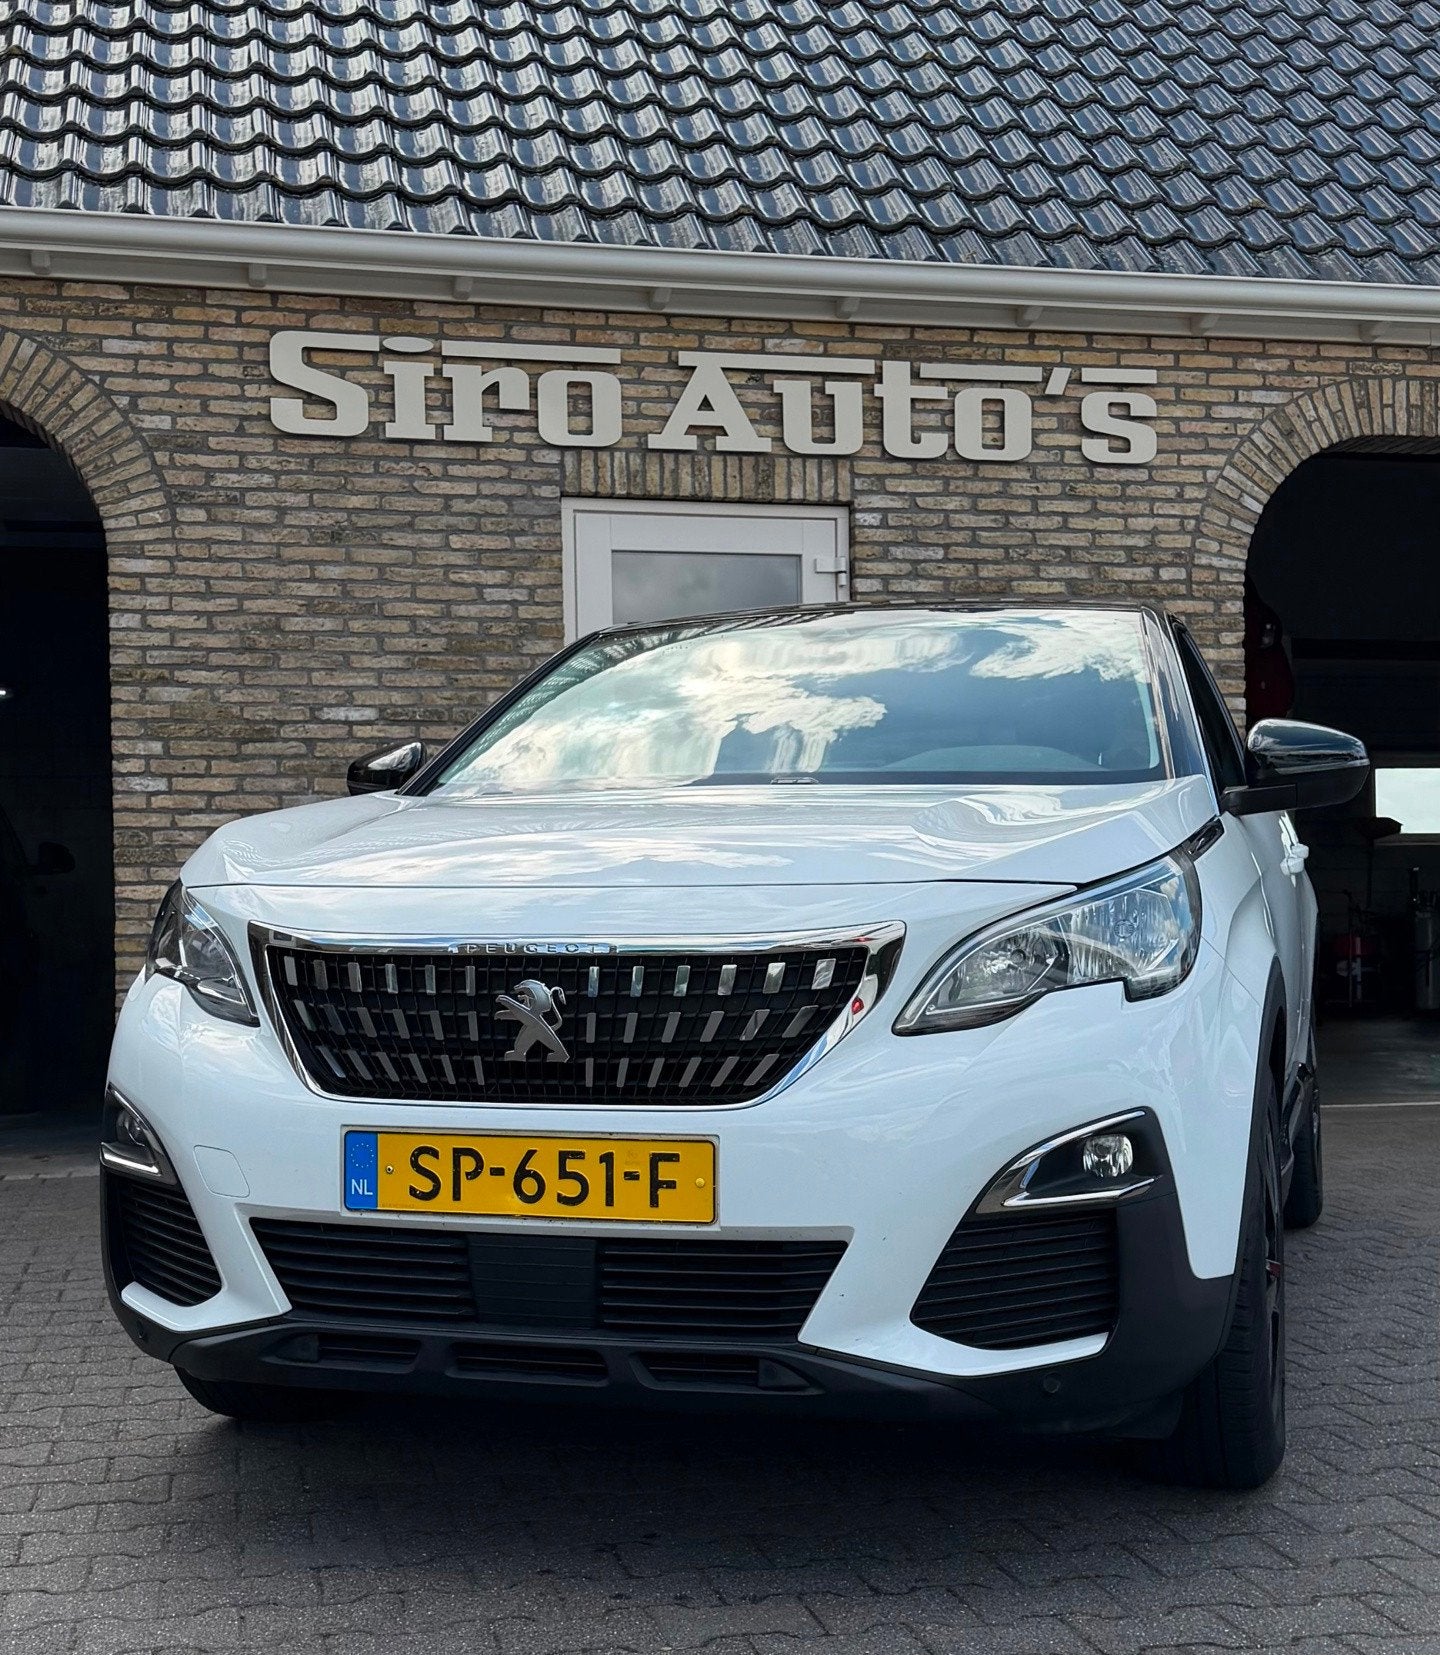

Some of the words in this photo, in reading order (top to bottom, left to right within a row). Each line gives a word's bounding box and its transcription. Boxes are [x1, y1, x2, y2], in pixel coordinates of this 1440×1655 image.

[269, 330, 623, 447] Siro
[647, 350, 1158, 465] Auto's
[465, 943, 600, 954] PEUGEOT
[351, 1178, 373, 1196] NL
[408, 1145, 680, 1208] SP-651-F
